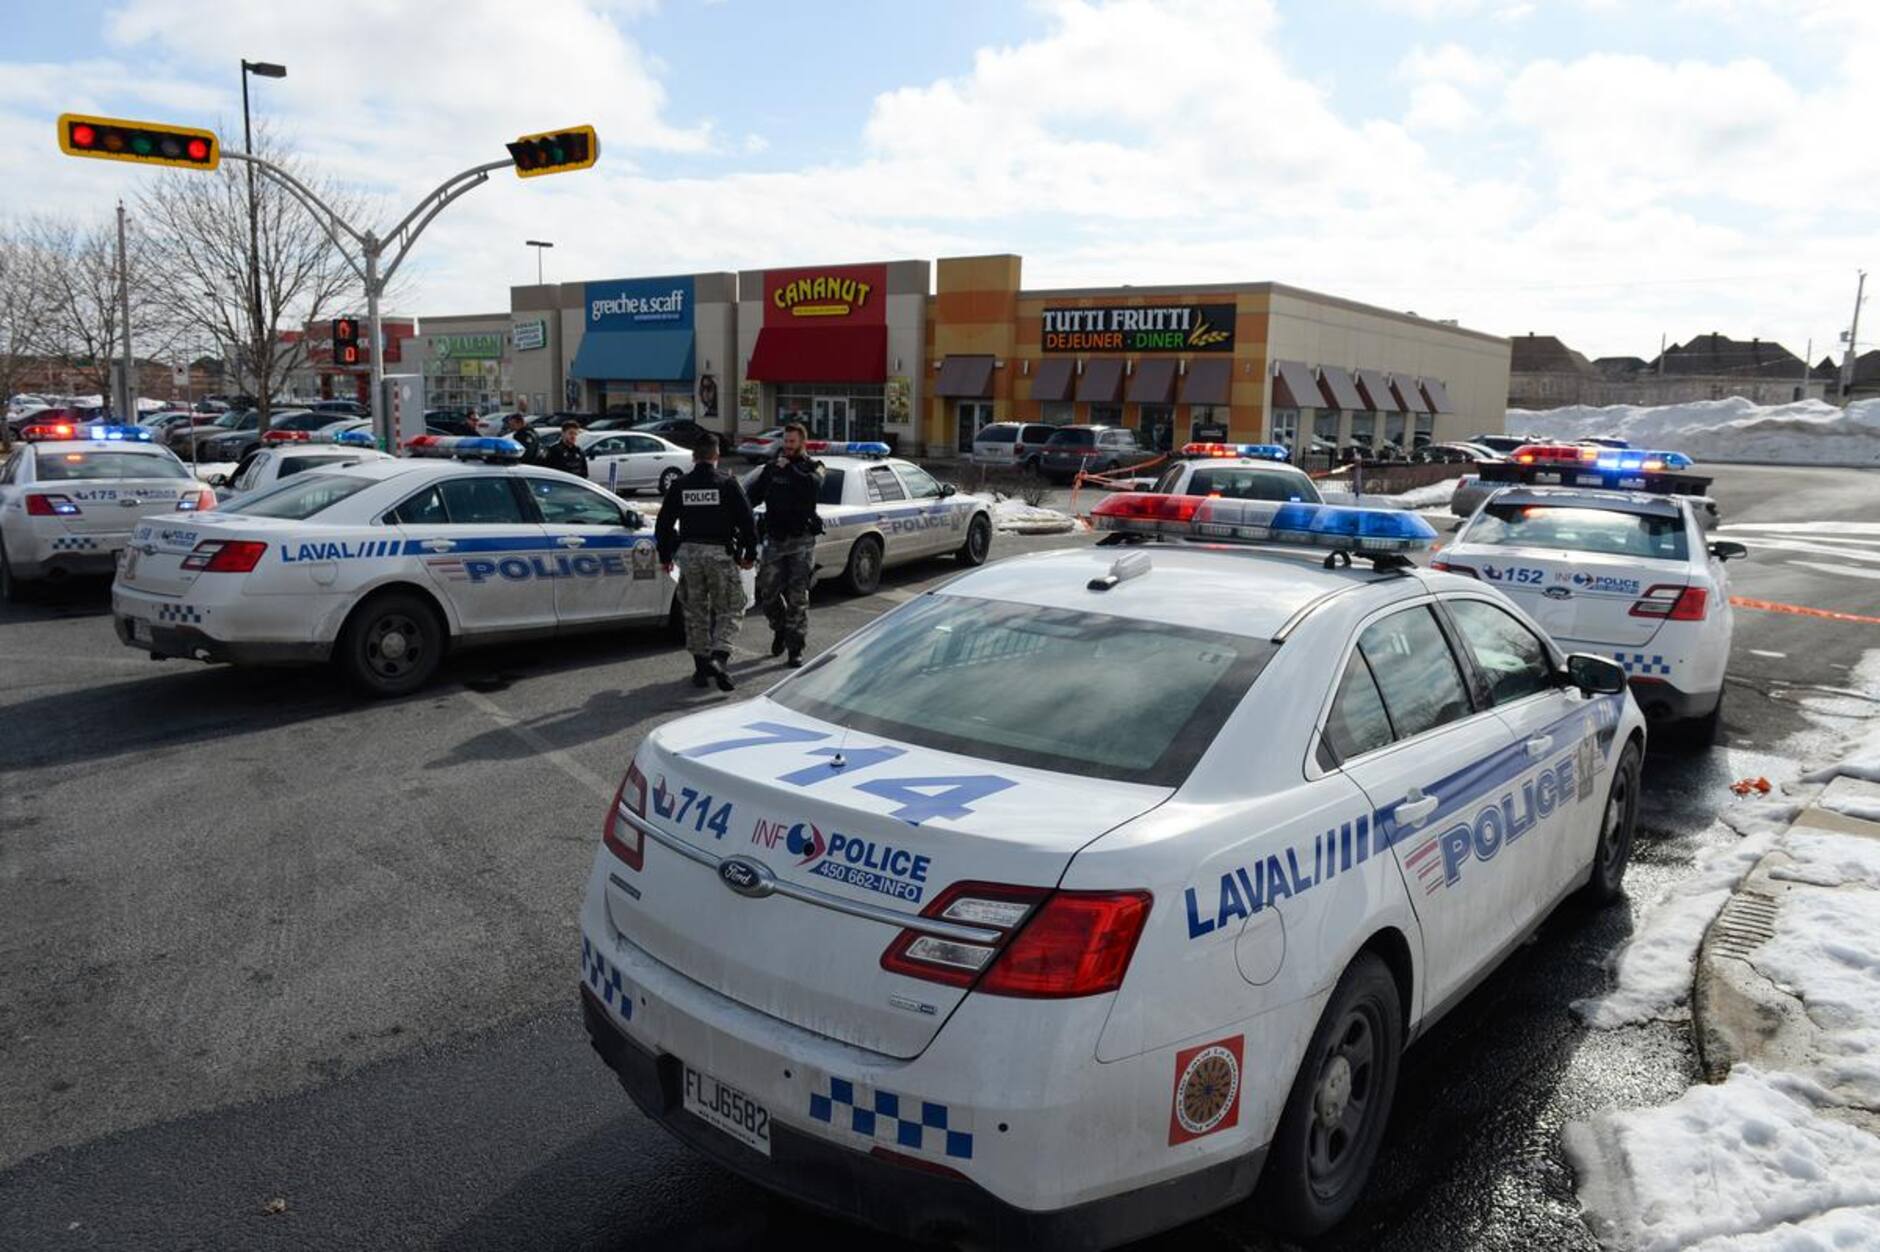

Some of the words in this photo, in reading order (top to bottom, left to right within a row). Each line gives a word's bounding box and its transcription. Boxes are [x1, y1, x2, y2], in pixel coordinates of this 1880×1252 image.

[592, 292, 638, 321] greiche
[639, 298, 650, 313] &
[650, 289, 684, 313] scaff
[774, 277, 870, 308] CANANUT
[1042, 309, 1104, 331] TUTTI
[1111, 308, 1191, 330] FRUTTI
[1046, 333, 1123, 349] DEJEUNER
[1136, 333, 1185, 348] DINER
[89, 490, 117, 500] 175
[684, 491, 720, 503] POLICE
[892, 517, 950, 534] POLICE
[281, 541, 358, 563] LAVAL
[461, 553, 628, 584] POLICE
[1504, 567, 1544, 585] 152
[1595, 576, 1640, 588] POLICE
[681, 786, 733, 841] 714
[1440, 758, 1578, 889] POLICE
[826, 833, 931, 884] POLICE
[725, 861, 751, 886] Ford
[819, 861, 845, 881] 450
[847, 864, 921, 902] 662-INFO
[1184, 847, 1312, 941] LAVAL
[686, 1067, 769, 1140] FLJ6582
